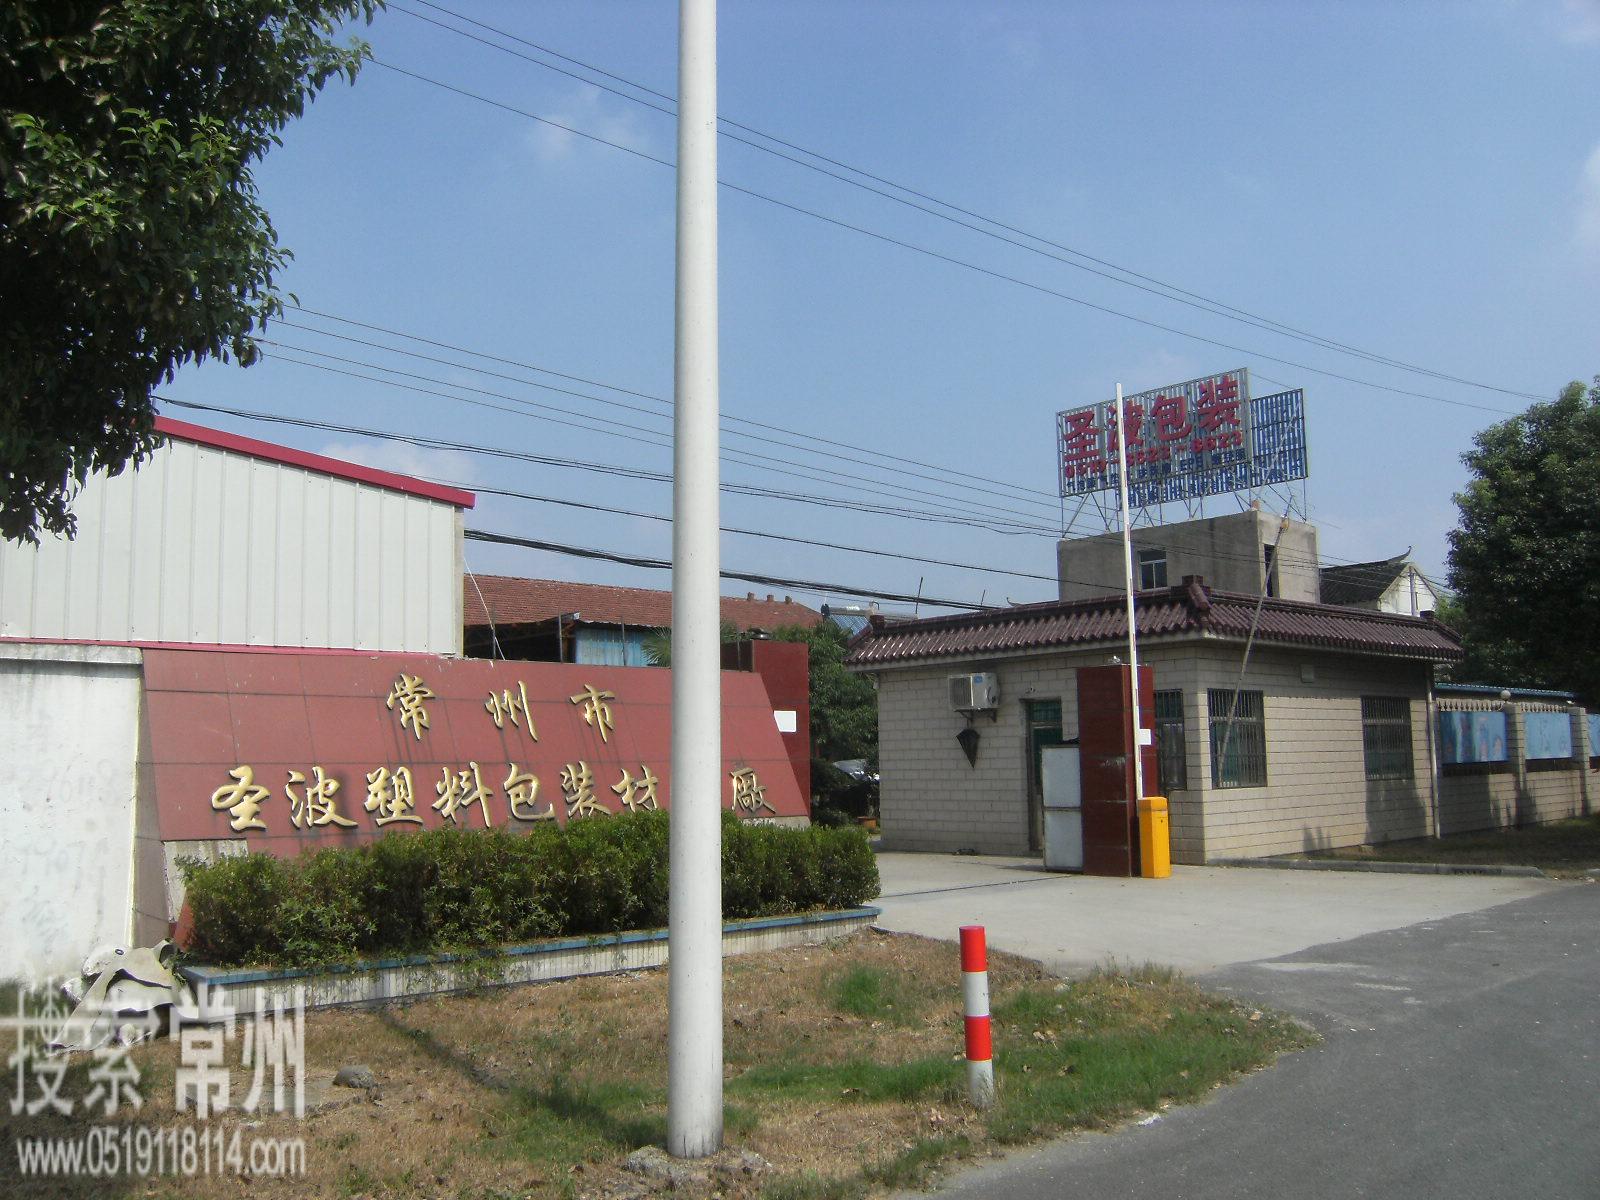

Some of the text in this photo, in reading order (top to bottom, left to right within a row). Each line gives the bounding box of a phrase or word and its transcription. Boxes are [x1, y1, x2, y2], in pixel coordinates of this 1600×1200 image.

[1064, 375, 1241, 462] 圣波包装
[387, 673, 616, 743] 常州市
